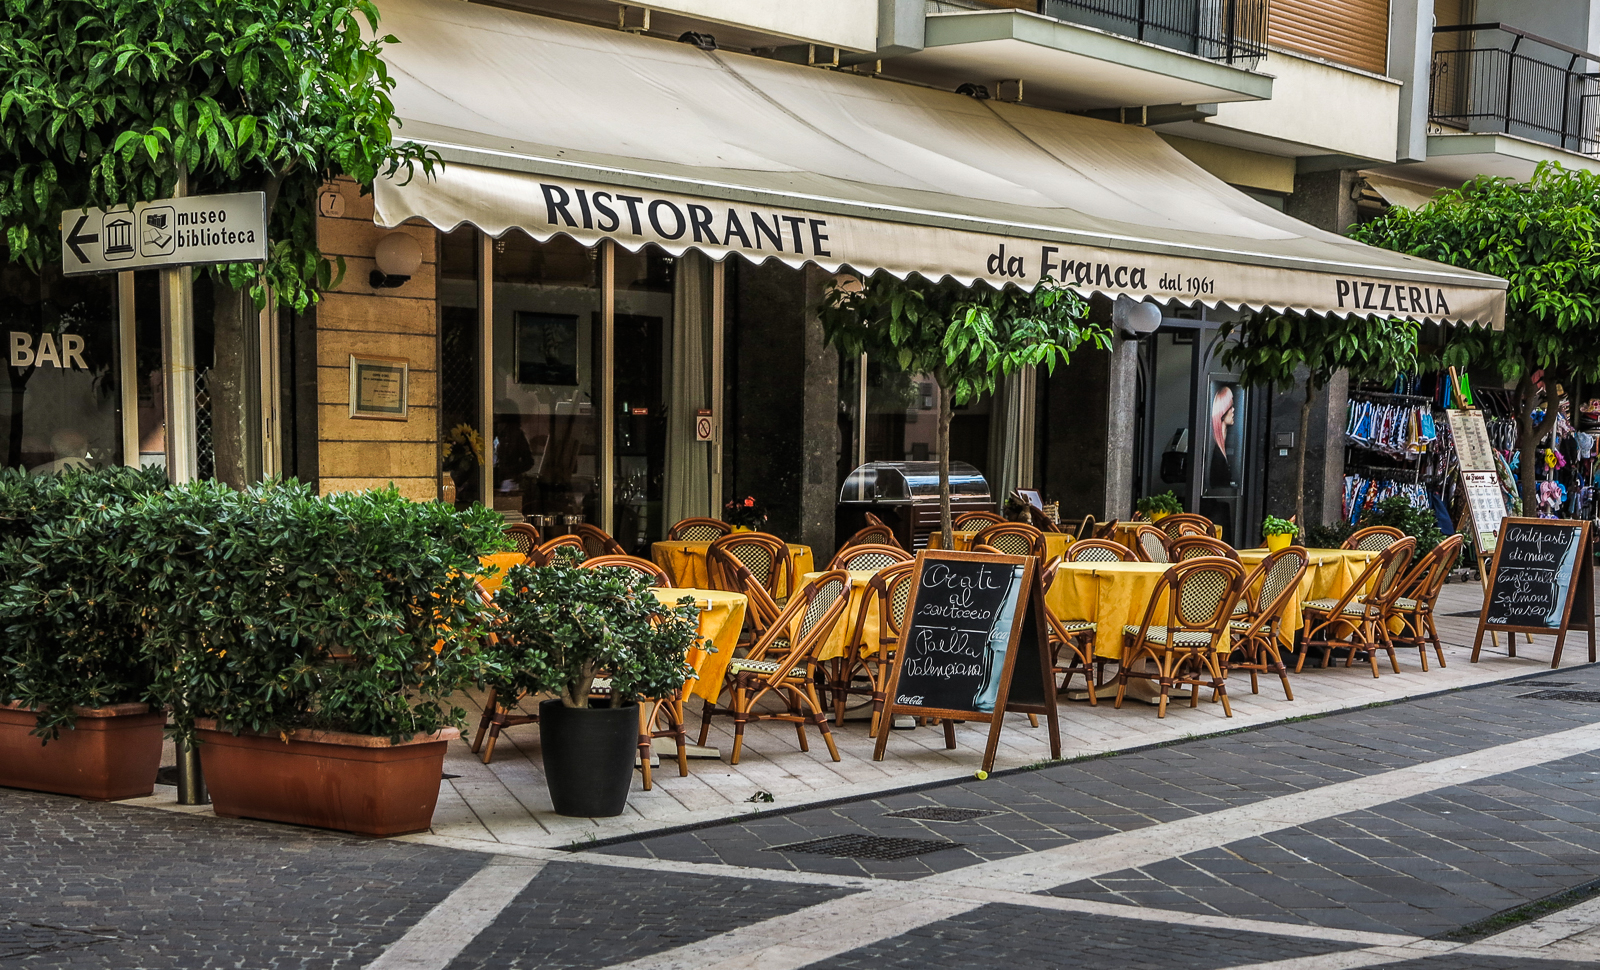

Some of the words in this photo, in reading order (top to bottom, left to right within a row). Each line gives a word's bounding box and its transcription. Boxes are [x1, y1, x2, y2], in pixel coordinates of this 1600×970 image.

[330, 194, 337, 209] 7
[177, 210, 227, 226] museo
[540, 184, 831, 257] RISTORANTE
[177, 227, 255, 248] biblioteca
[987, 243, 1026, 278] da
[1041, 246, 1147, 289] Franca
[1159, 273, 1183, 292] dal
[1186, 276, 1215, 297] 1961
[1336, 279, 1450, 315] PIZZERIA
[10, 331, 89, 369] BAR
[1505, 527, 1568, 553] Antipasti
[1509, 547, 1523, 560] di
[923, 564, 1001, 589] Orate
[949, 587, 974, 608] al
[1494, 591, 1549, 604] Salmone
[917, 603, 991, 619] cartoccio
[915, 628, 980, 658] Paella
